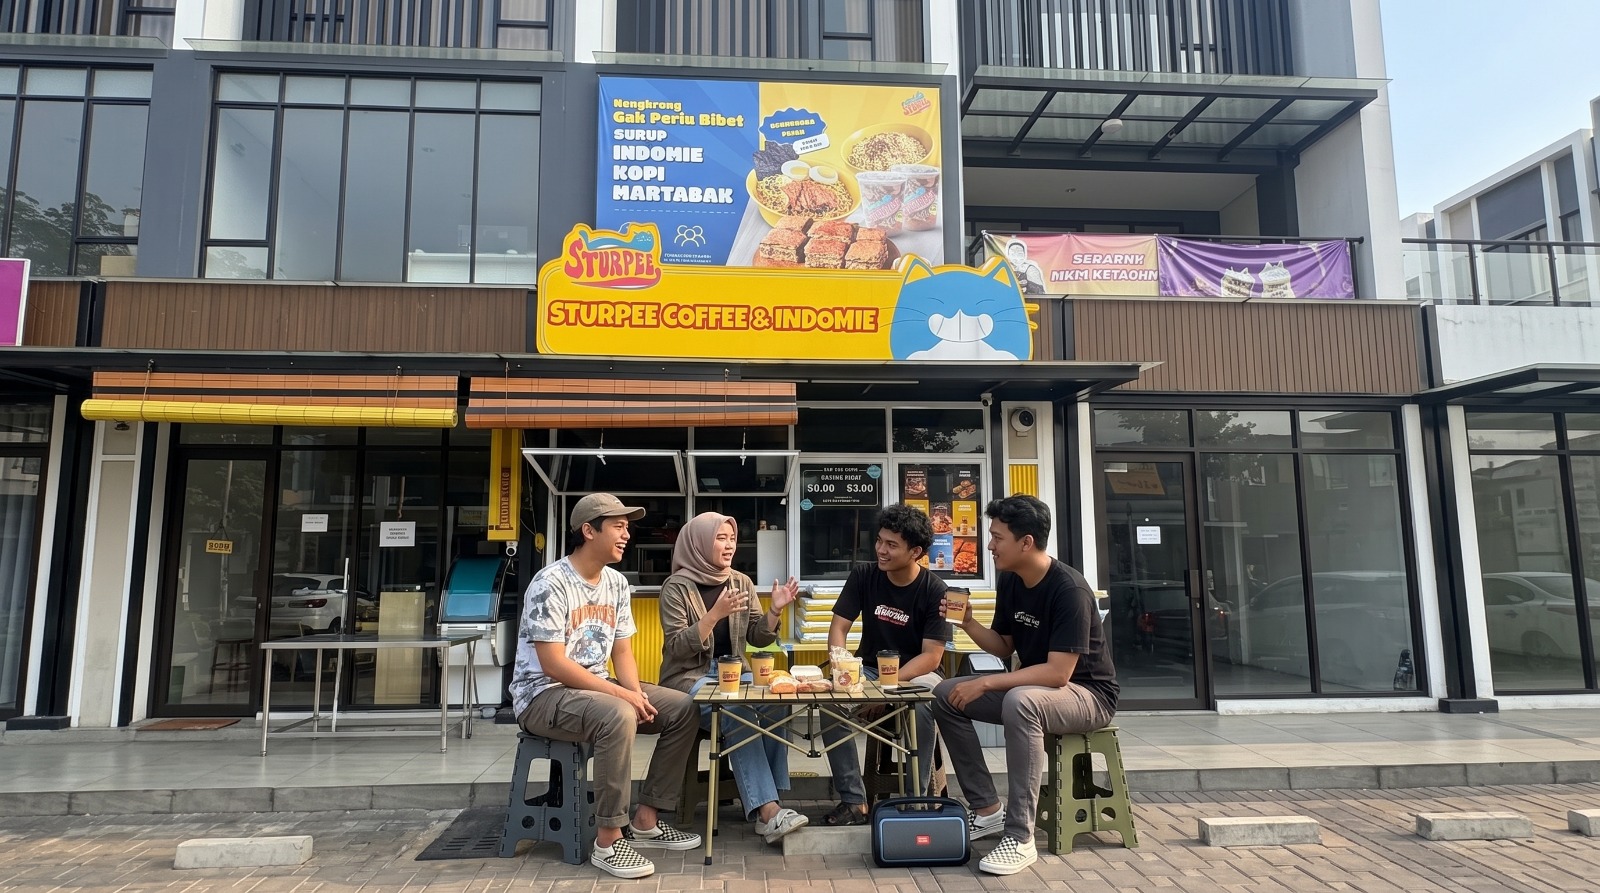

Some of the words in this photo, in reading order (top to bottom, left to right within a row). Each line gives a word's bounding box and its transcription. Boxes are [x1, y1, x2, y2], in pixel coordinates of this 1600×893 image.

[613, 111, 646, 124] Gak
[699, 113, 744, 127] Bibet
[613, 128, 667, 141] SURUP
[613, 145, 704, 163] INDOMIE
[613, 165, 665, 182] KOPI
[612, 184, 733, 204] MARTABAK
[564, 237, 655, 279] STURPEE
[548, 300, 660, 328] STURPEE
[661, 303, 750, 330] COFFEE
[751, 306, 772, 330] &
[773, 306, 879, 333] INDOMIE
